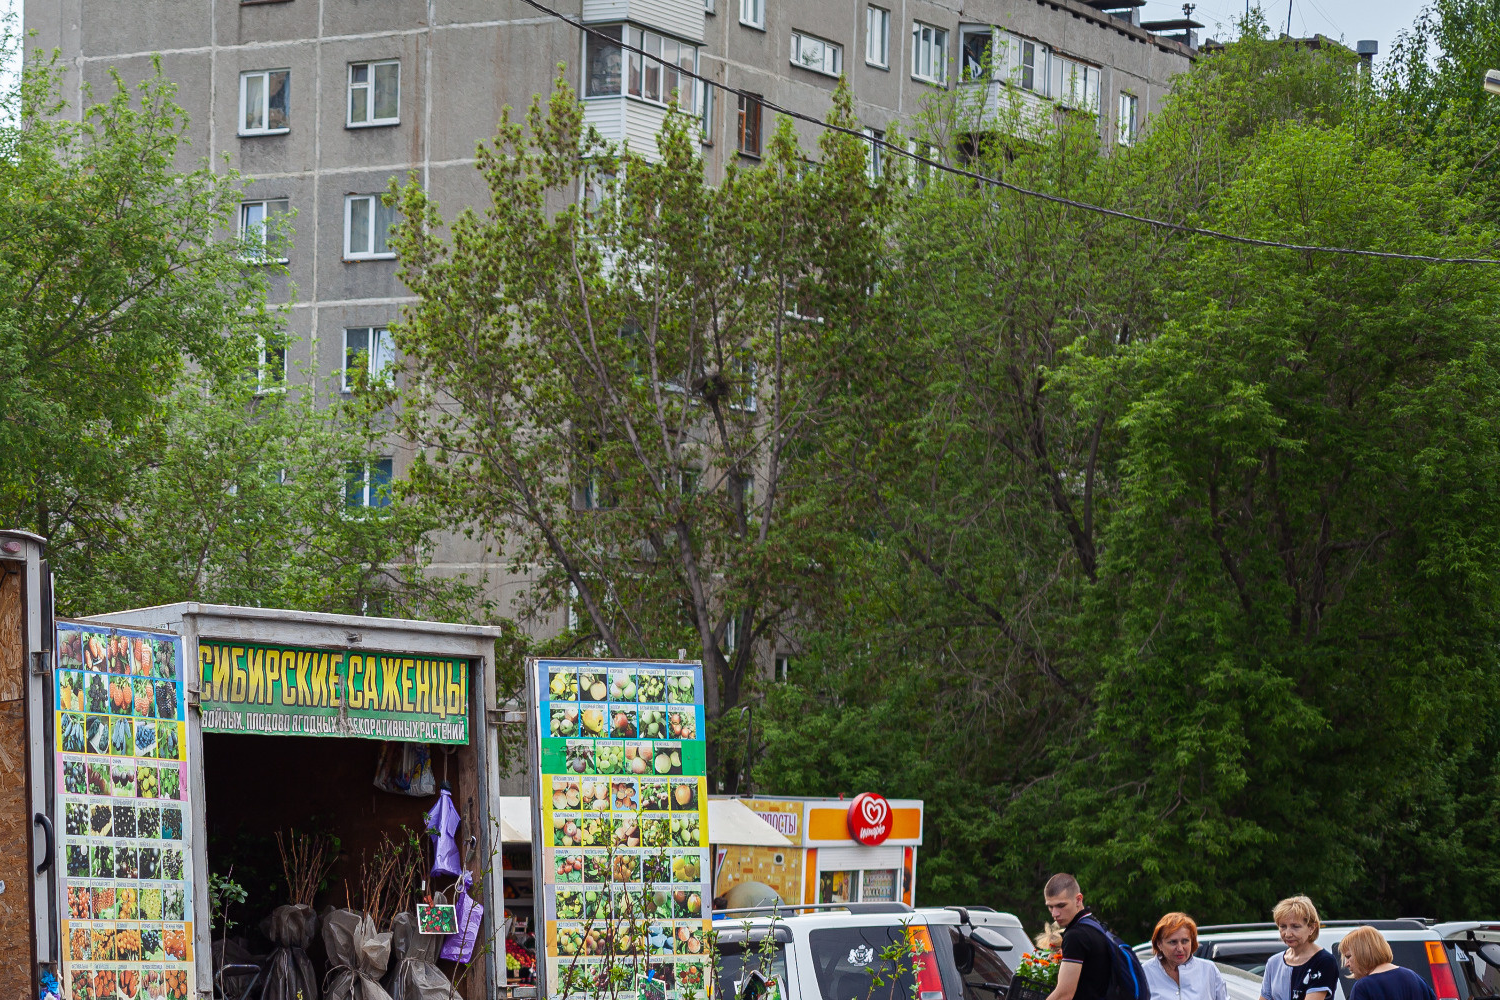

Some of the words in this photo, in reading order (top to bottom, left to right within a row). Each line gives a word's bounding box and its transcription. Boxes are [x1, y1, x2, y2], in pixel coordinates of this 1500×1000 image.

[199, 644, 343, 707] СИБИРСКИЕ
[347, 654, 467, 719] САЖЕНЦЫ
[246, 712, 290, 733] ПЛОДОВО
[292, 714, 337, 734] ЯГОДНЫХ
[419, 720, 465, 740] РАСТЕНИЙ
